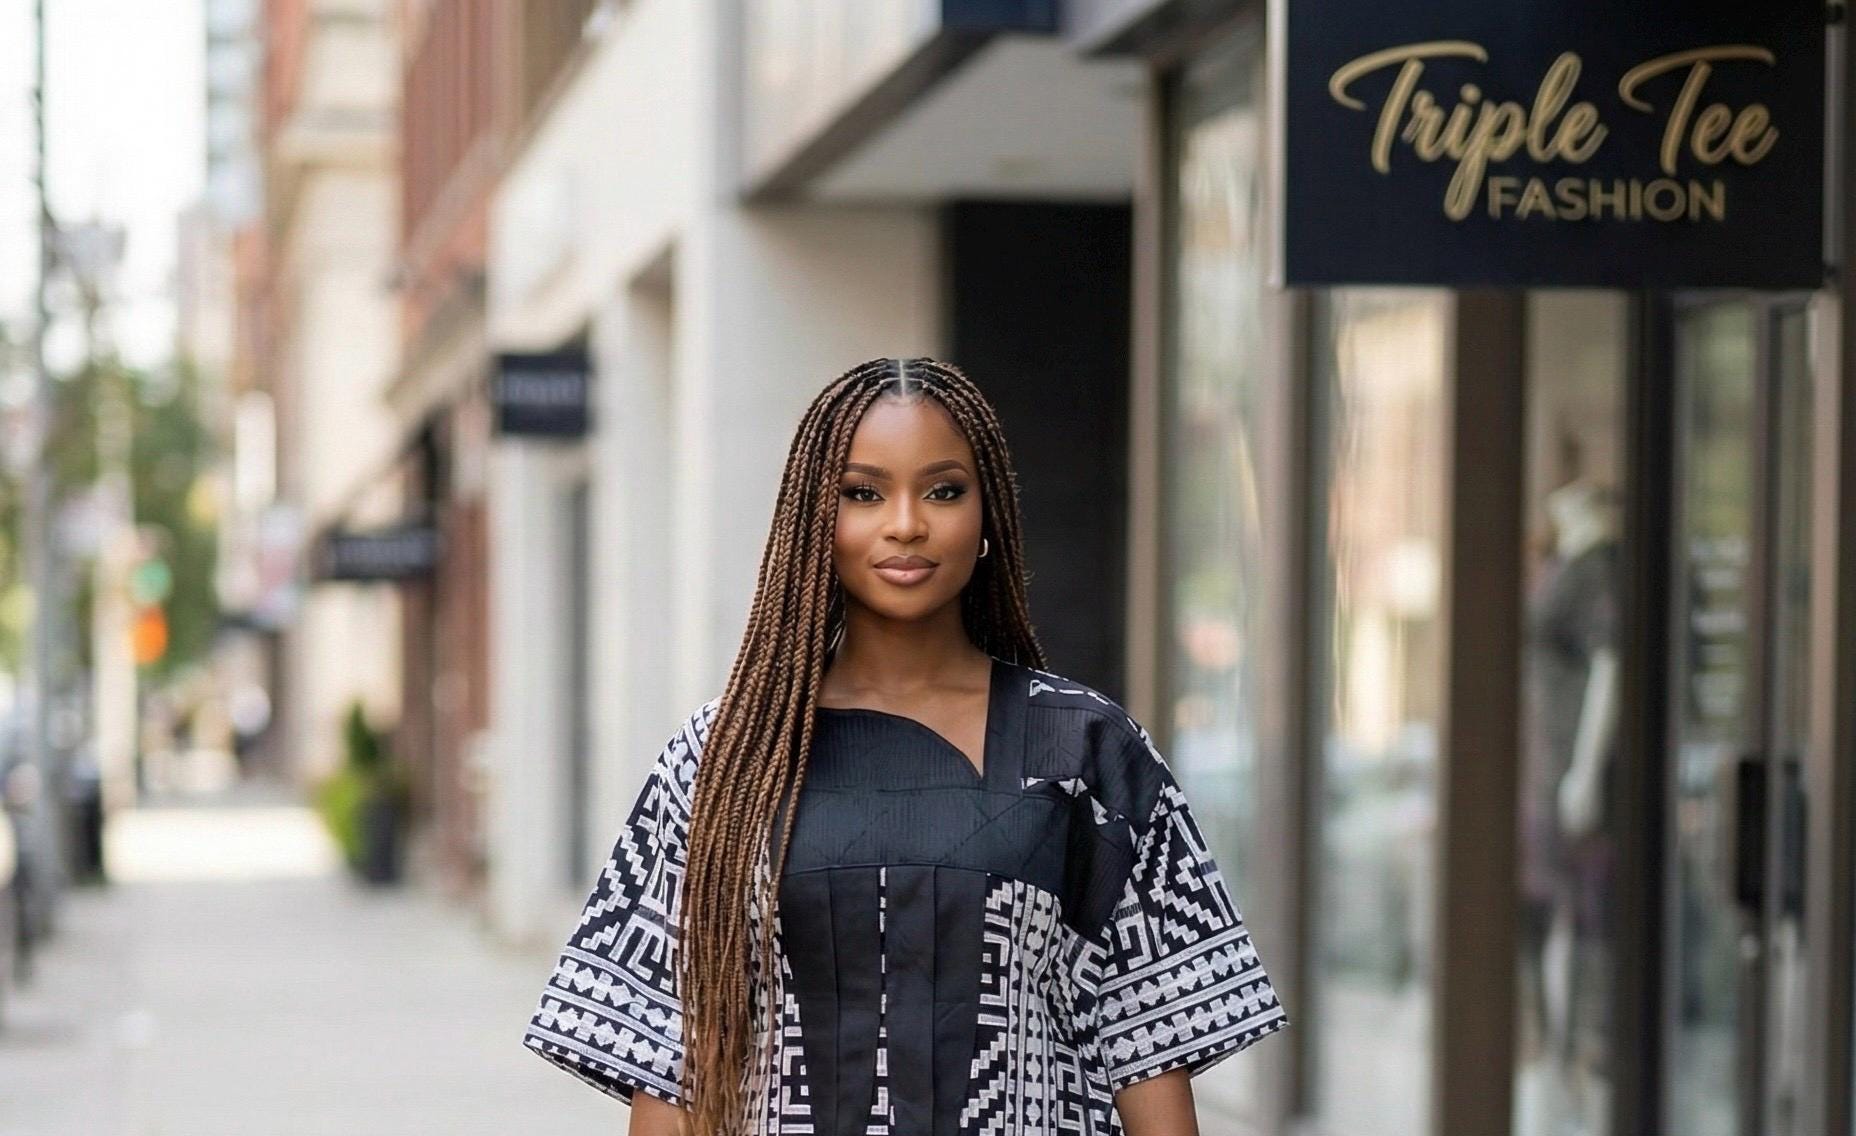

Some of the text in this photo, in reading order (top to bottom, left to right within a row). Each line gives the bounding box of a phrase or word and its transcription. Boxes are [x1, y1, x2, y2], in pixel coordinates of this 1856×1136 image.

[1328, 40, 1779, 221] Triple Tee
[1488, 177, 1726, 221] FASHION
